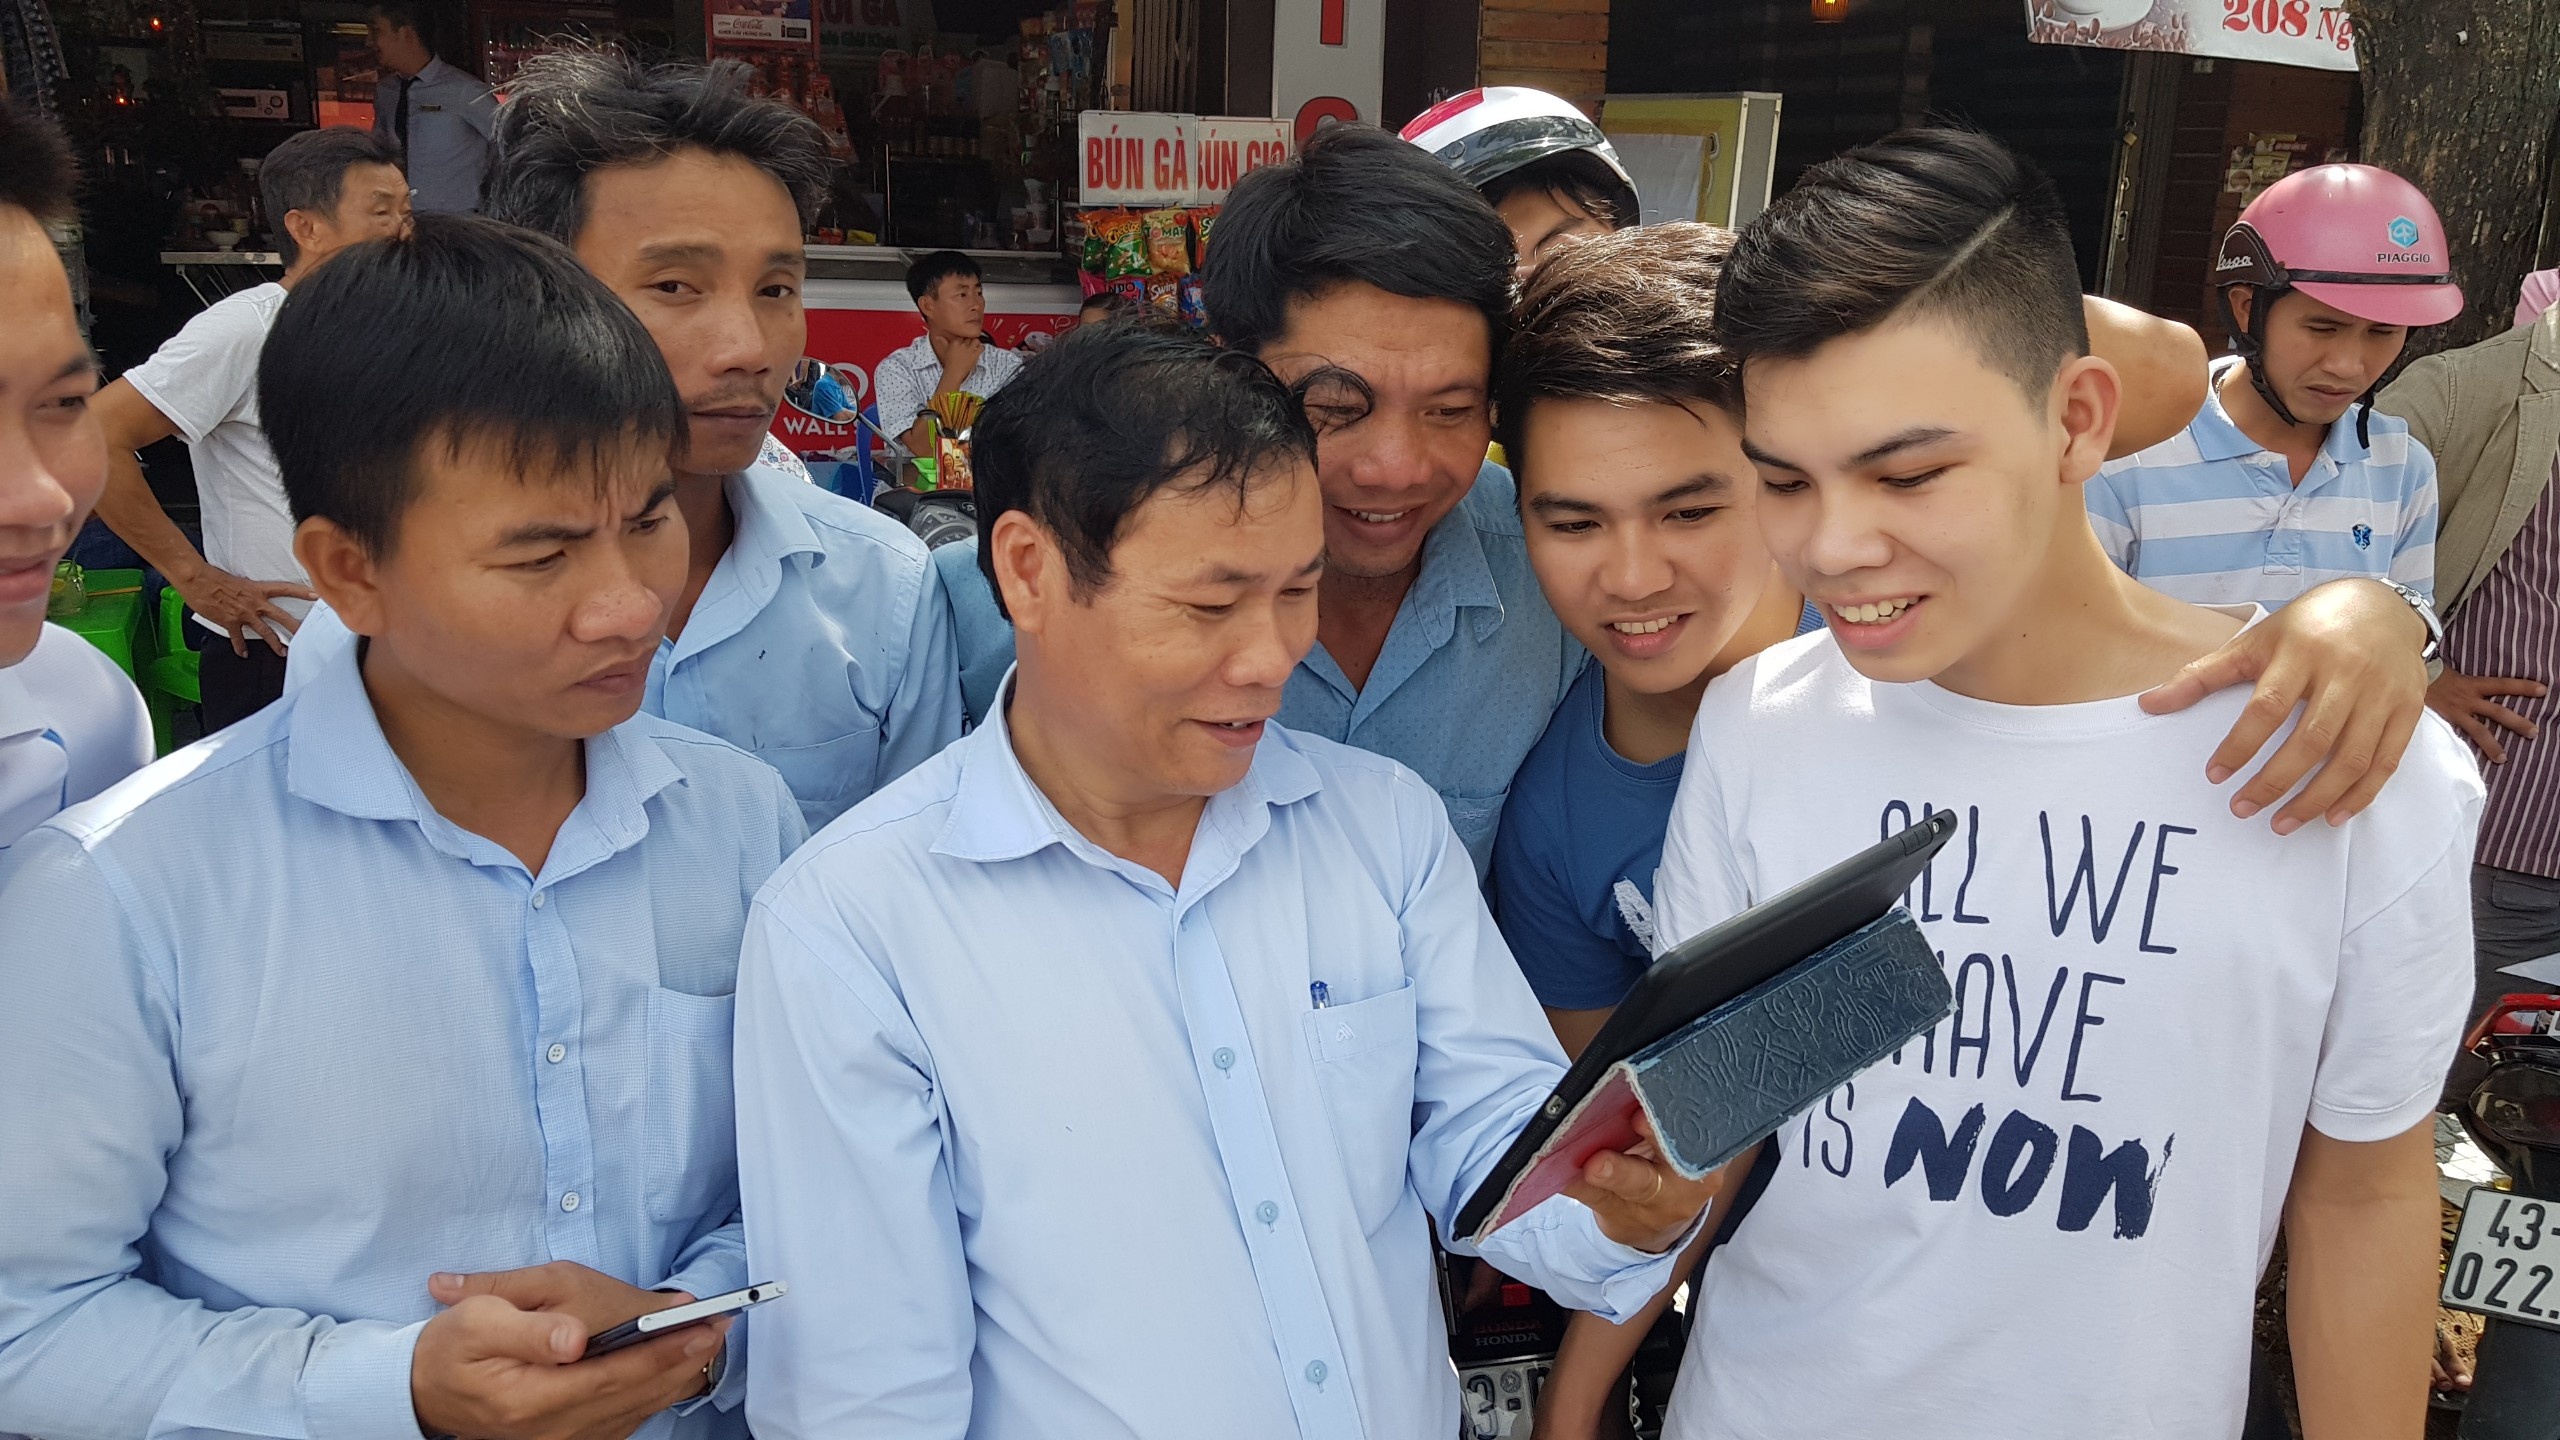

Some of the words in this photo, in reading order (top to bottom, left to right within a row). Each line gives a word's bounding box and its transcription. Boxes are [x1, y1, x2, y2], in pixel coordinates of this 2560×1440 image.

[2222, 0, 2310, 37] 208
[2315, 6, 2353, 51] Ng
[1087, 124, 1144, 190] BÚN
[1153, 126, 1189, 191] GÀ
[1106, 222, 1141, 244] Cheetos
[2216, 254, 2254, 272] Vespa
[2376, 252, 2431, 264] PIAGGIO
[1151, 281, 1178, 301] Swing
[783, 417, 858, 436] WALL
[2039, 810, 2198, 955] WE
[1803, 1081, 1854, 1178] IS
[1884, 1096, 2177, 1241] NOW
[1475, 1333, 1542, 1347] HONDA
